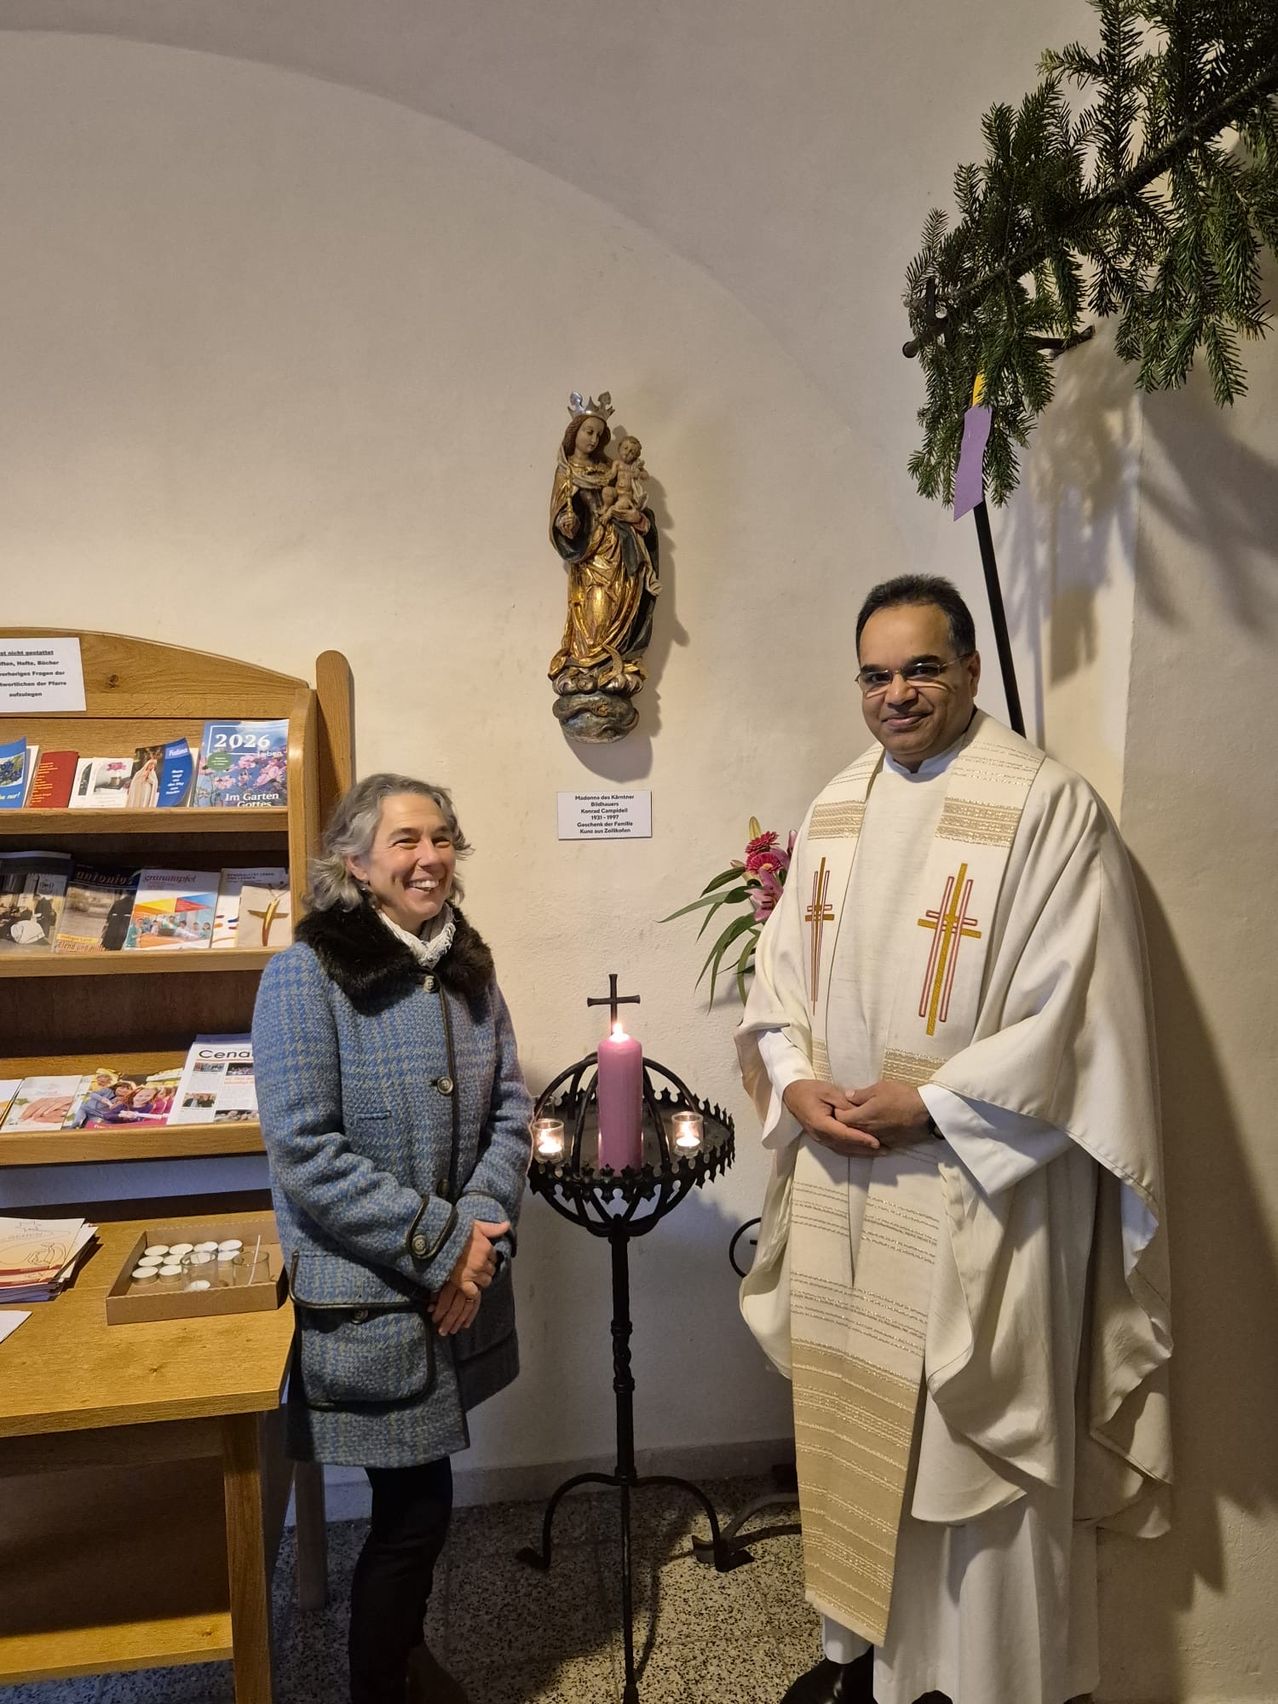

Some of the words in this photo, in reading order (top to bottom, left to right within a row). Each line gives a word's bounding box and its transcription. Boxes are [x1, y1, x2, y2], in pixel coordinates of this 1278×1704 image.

[214, 733, 271, 748] 2026
[225, 793, 240, 801] Im
[242, 792, 279, 801] Garten
[198, 1049, 253, 1058] Cena
